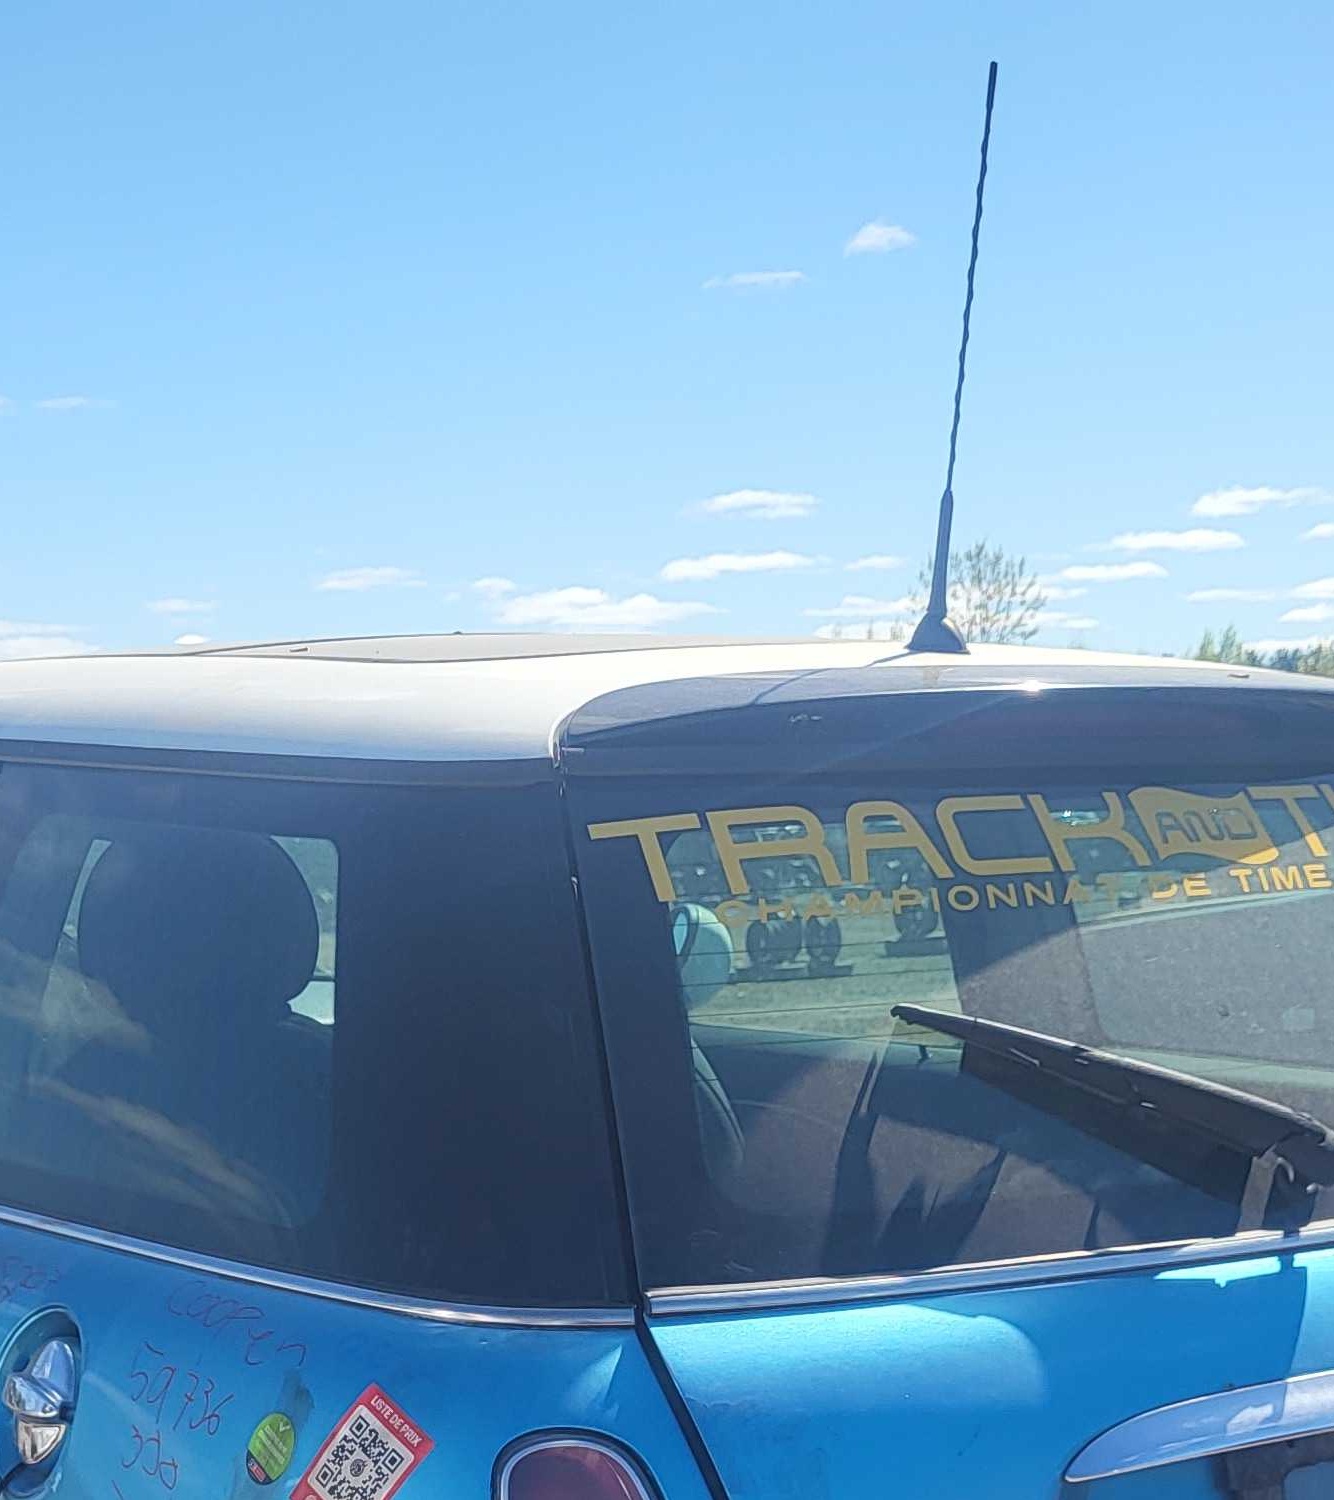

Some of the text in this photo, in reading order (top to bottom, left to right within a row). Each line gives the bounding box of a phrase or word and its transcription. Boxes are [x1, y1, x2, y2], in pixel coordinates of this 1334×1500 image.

[587, 791, 1150, 902] TRACK
[1153, 808, 1259, 843] AND
[1230, 862, 1332, 894] TIME
[370, 1394, 423, 1448] LISTE DE PRIX
